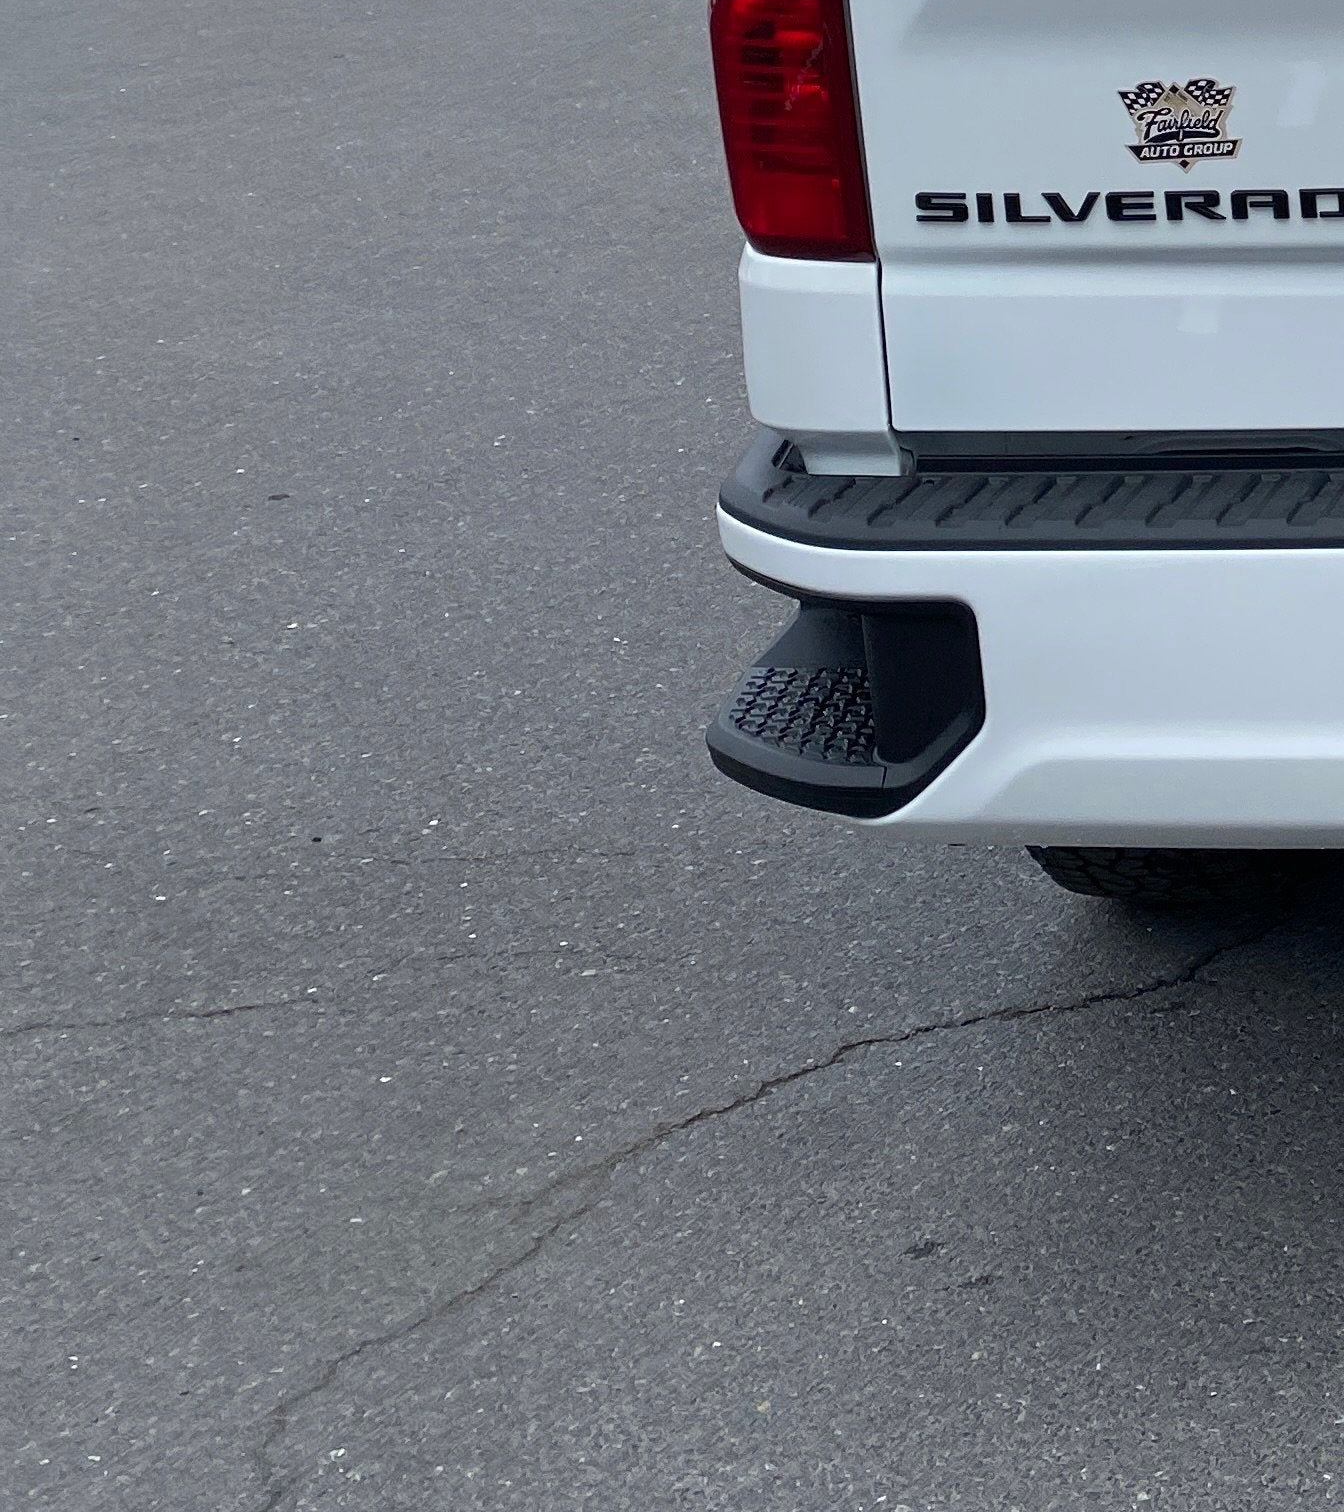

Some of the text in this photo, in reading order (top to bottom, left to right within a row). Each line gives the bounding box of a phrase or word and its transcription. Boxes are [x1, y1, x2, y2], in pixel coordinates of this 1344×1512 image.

[1136, 106, 1225, 141] Fairfield
[1139, 142, 1234, 159] AUTO GROUP
